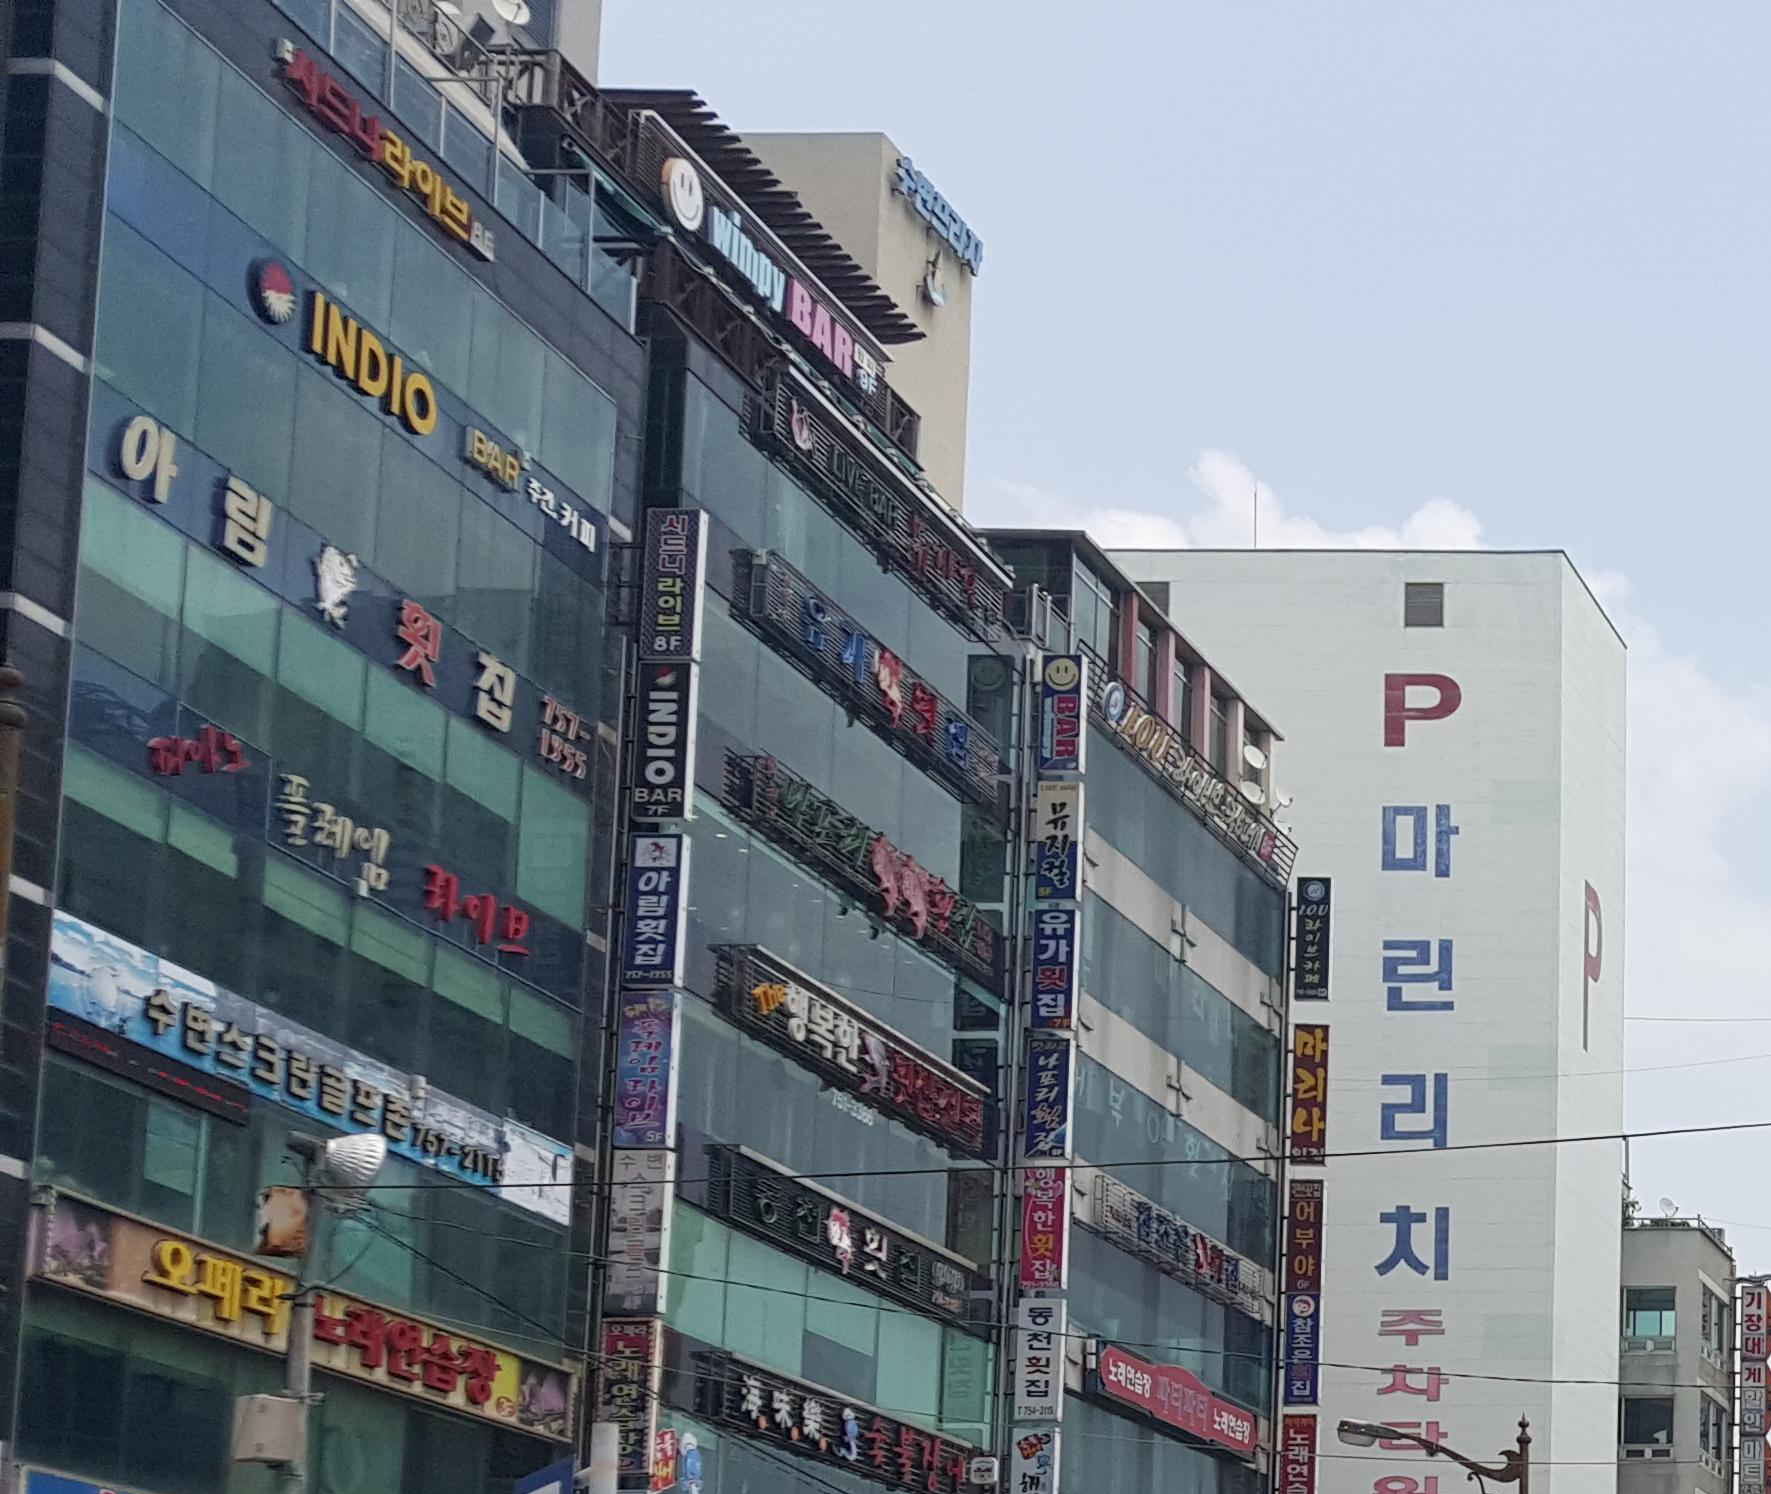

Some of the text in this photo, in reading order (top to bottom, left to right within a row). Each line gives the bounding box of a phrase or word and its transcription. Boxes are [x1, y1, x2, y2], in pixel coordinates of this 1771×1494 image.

[787, 276, 854, 379] BAR
[311, 291, 521, 490] INDIO BAR
[653, 635, 683, 651] 8F
[644, 690, 679, 786] INDIO
[1053, 696, 1079, 758] BAR
[1383, 672, 1463, 748] P
[277, 772, 391, 891] 플레임
[633, 787, 683, 804] BAR
[645, 804, 670, 817] 7F
[633, 869, 674, 966] 아림횟집
[1036, 911, 1071, 1018] 유가횟집
[1583, 878, 1604, 1053] P
[752, 980, 862, 1076] The 행복한
[1374, 803, 1460, 1283] 마린리치
[1292, 1028, 1327, 1143] 마리나
[1031, 1167, 1060, 1281] 행복한횟집
[1293, 1202, 1318, 1276] 어부야
[142, 1240, 502, 1408] 오페라 노래연습장
[1024, 1307, 1054, 1399] 동천횟집
[1743, 1290, 1764, 1384] 기장대게
[1107, 1356, 1252, 1445] 노래연습장 노래연습장
